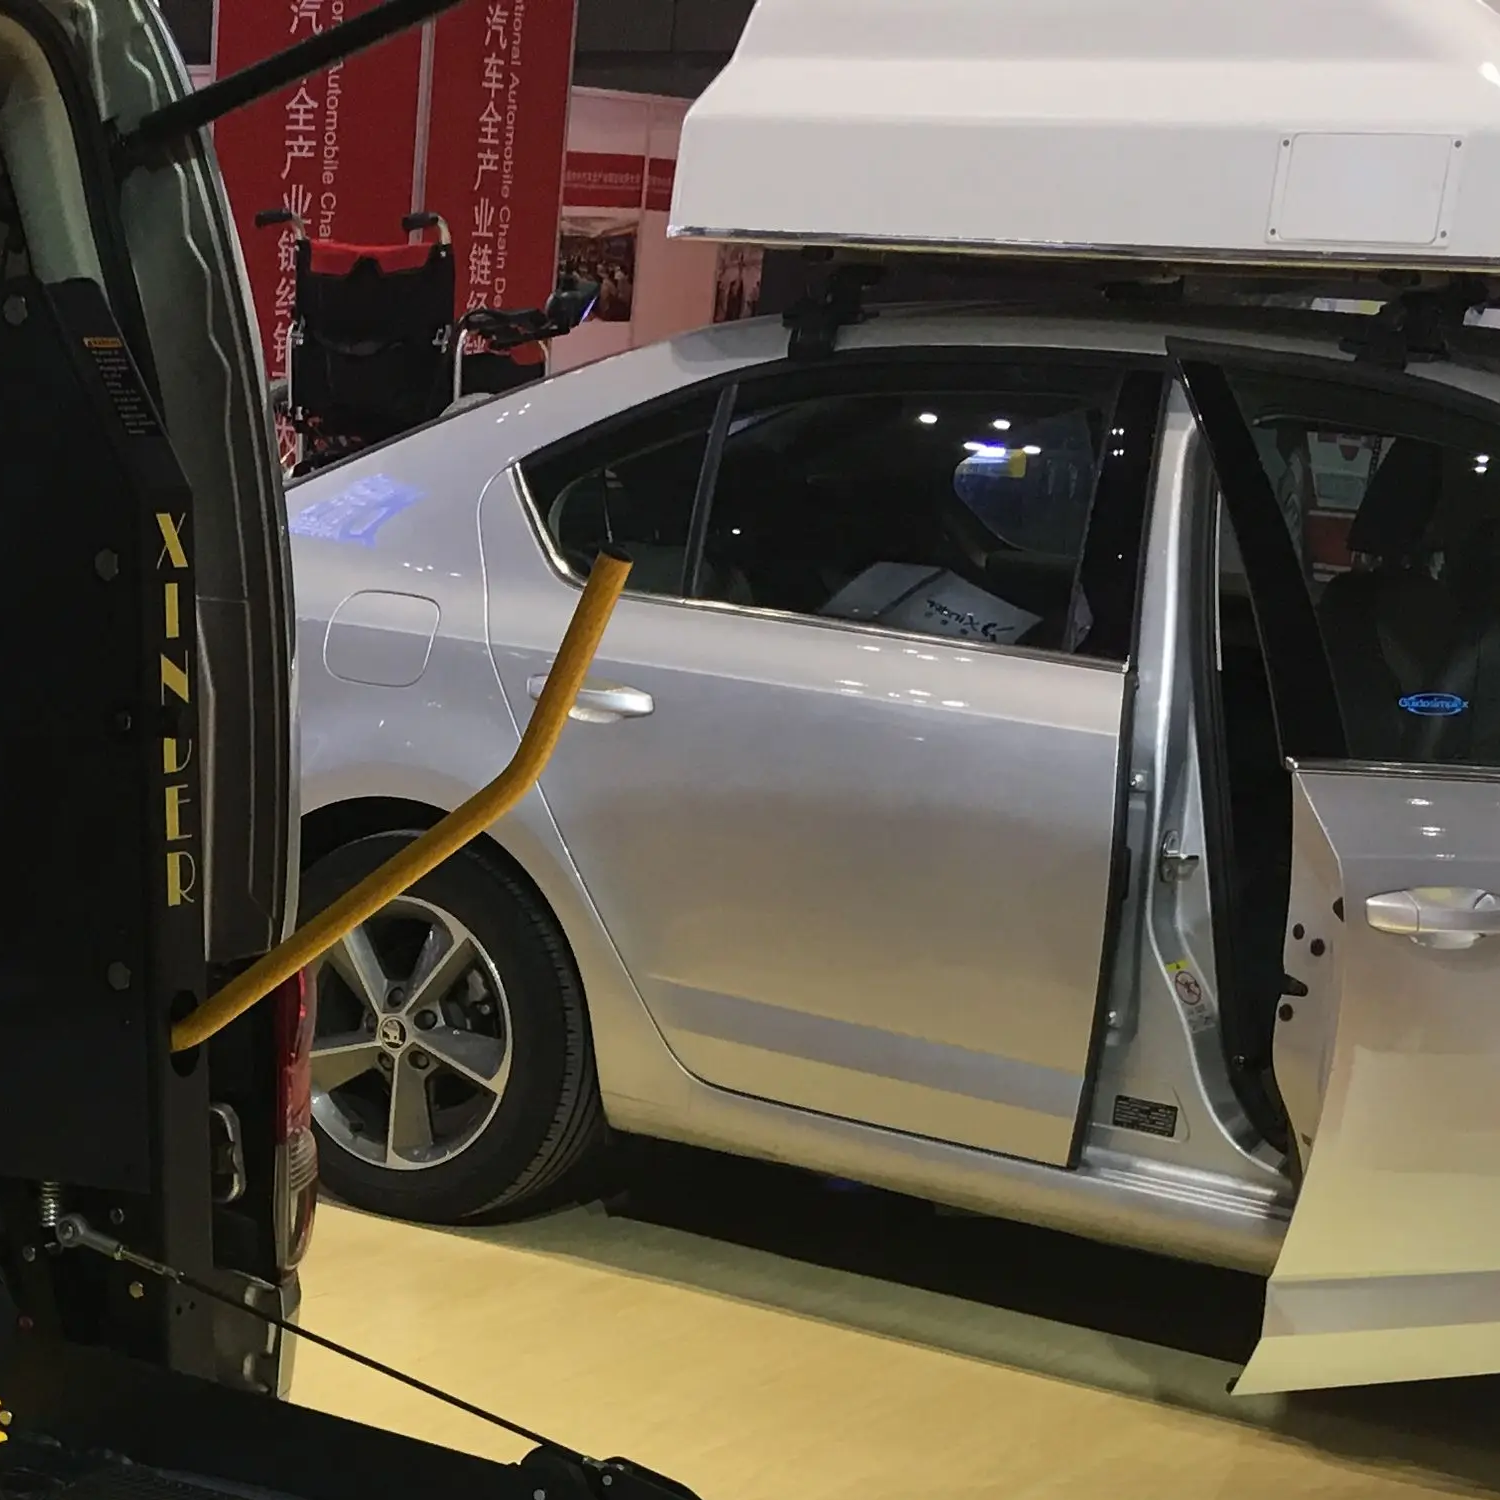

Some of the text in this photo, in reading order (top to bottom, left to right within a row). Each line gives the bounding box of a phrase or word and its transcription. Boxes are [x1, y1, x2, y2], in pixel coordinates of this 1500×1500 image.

[493, 0, 525, 308] tional Automobile Chain De
[156, 512, 196, 907] XINDER
